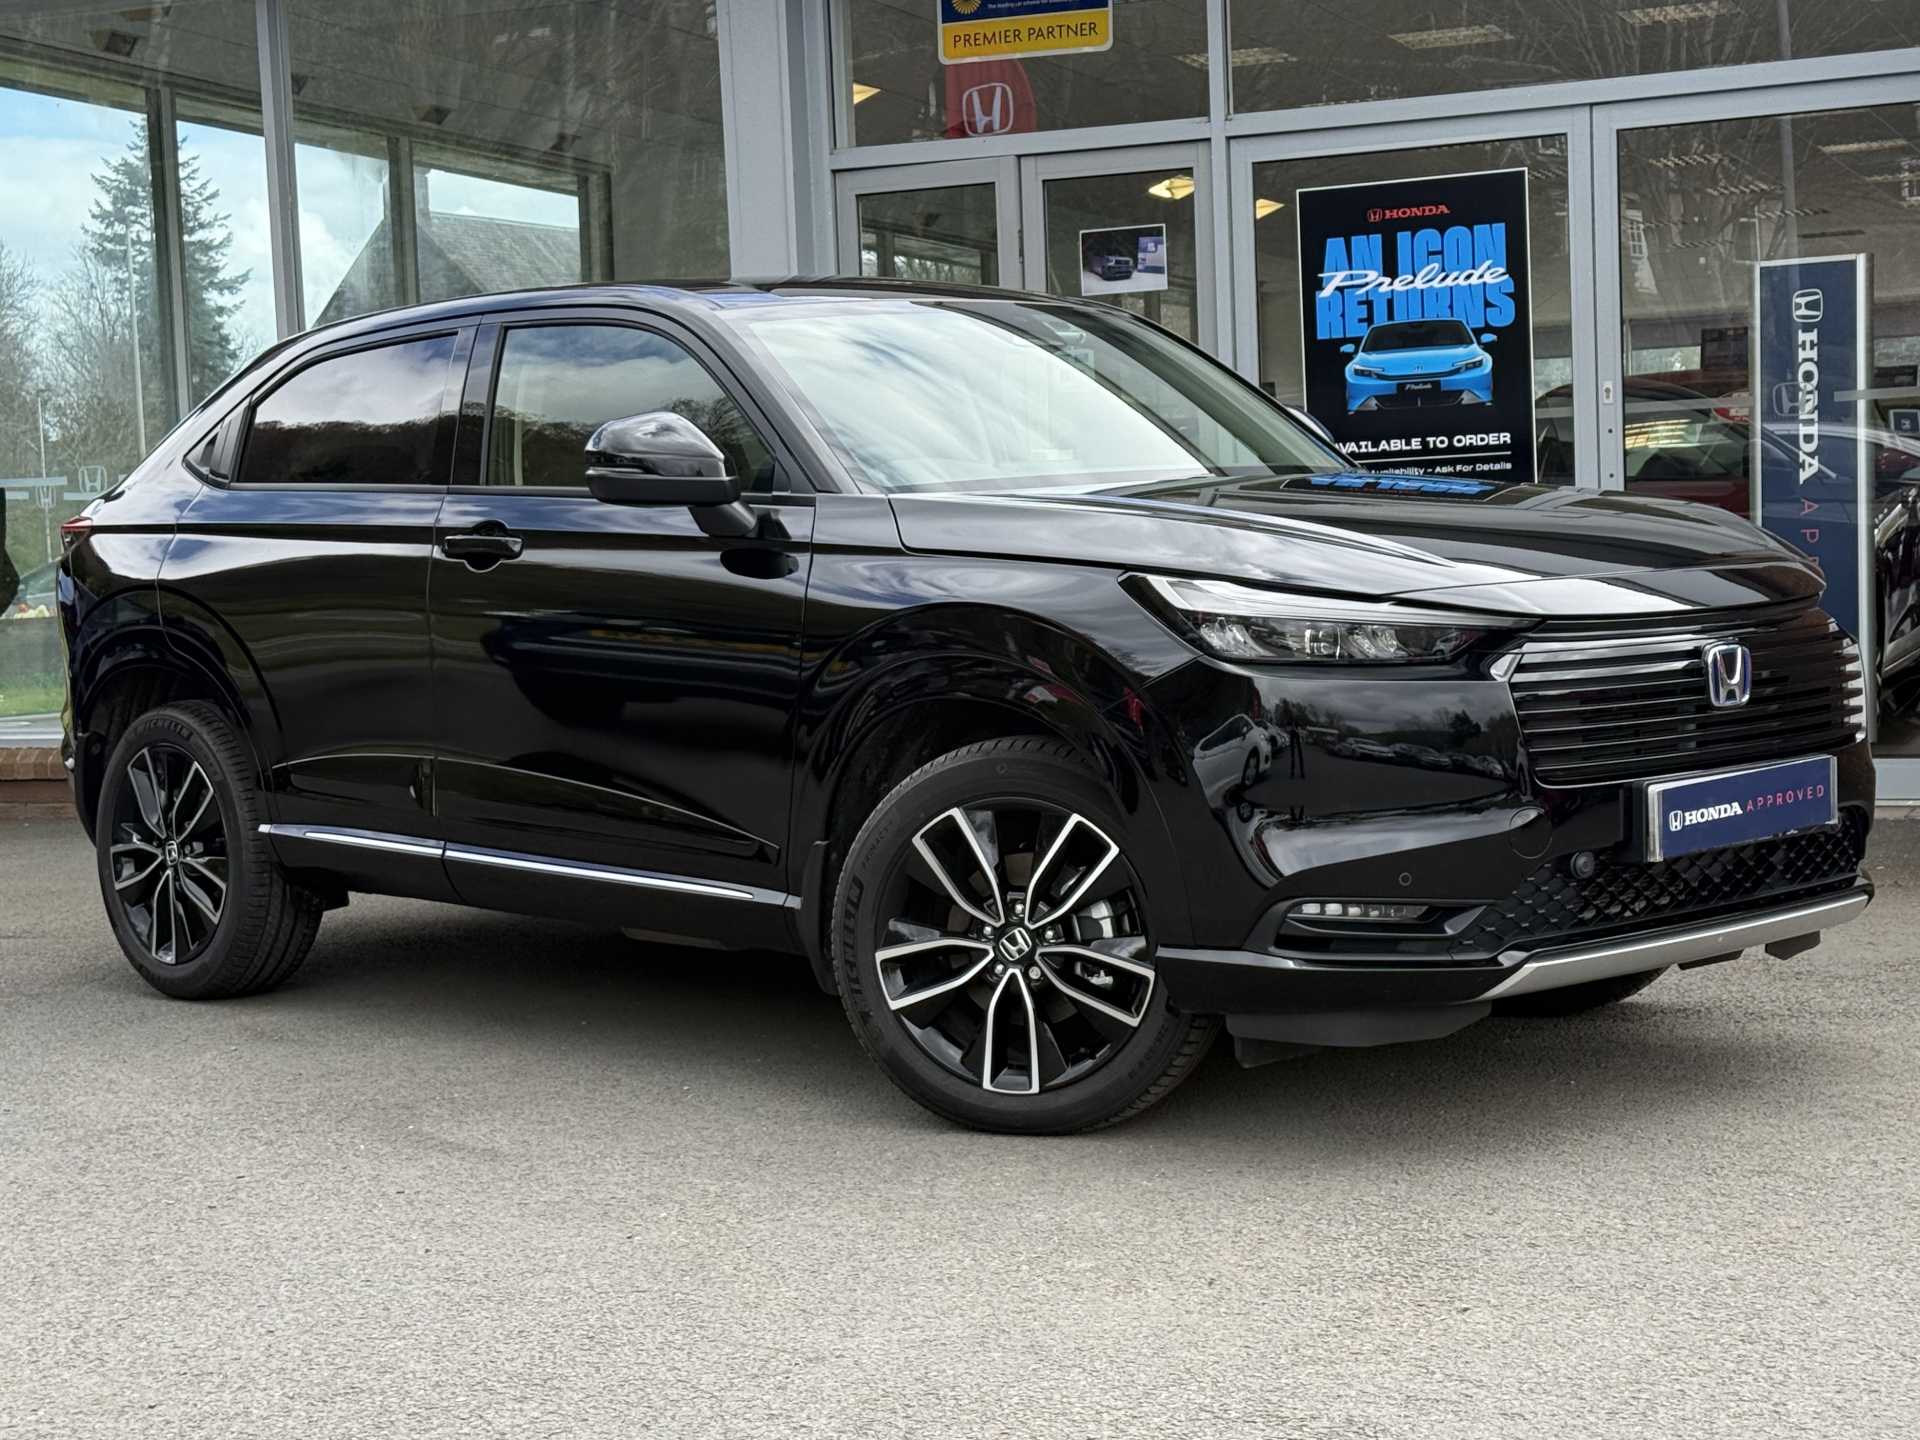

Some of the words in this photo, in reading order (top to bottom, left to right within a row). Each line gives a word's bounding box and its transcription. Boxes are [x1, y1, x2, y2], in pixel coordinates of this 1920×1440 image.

[953, 29, 1023, 48] PREMIER
[1028, 22, 1098, 41] PARTNER
[1384, 204, 1450, 220] HONDA
[1322, 234, 1383, 287] AN
[1397, 222, 1507, 280] ICON
[1317, 260, 1509, 297] Prelude
[1316, 278, 1516, 340] RETURNS
[1797, 328, 1820, 485] HONDA
[1426, 436, 1449, 448] TO
[1453, 432, 1511, 447] ORDER
[1434, 465, 1454, 474] Ask
[1456, 464, 1474, 472] For
[1475, 462, 1513, 471] Details
[1684, 801, 1743, 826] HONDA
[1746, 784, 1825, 813] APPROVED
